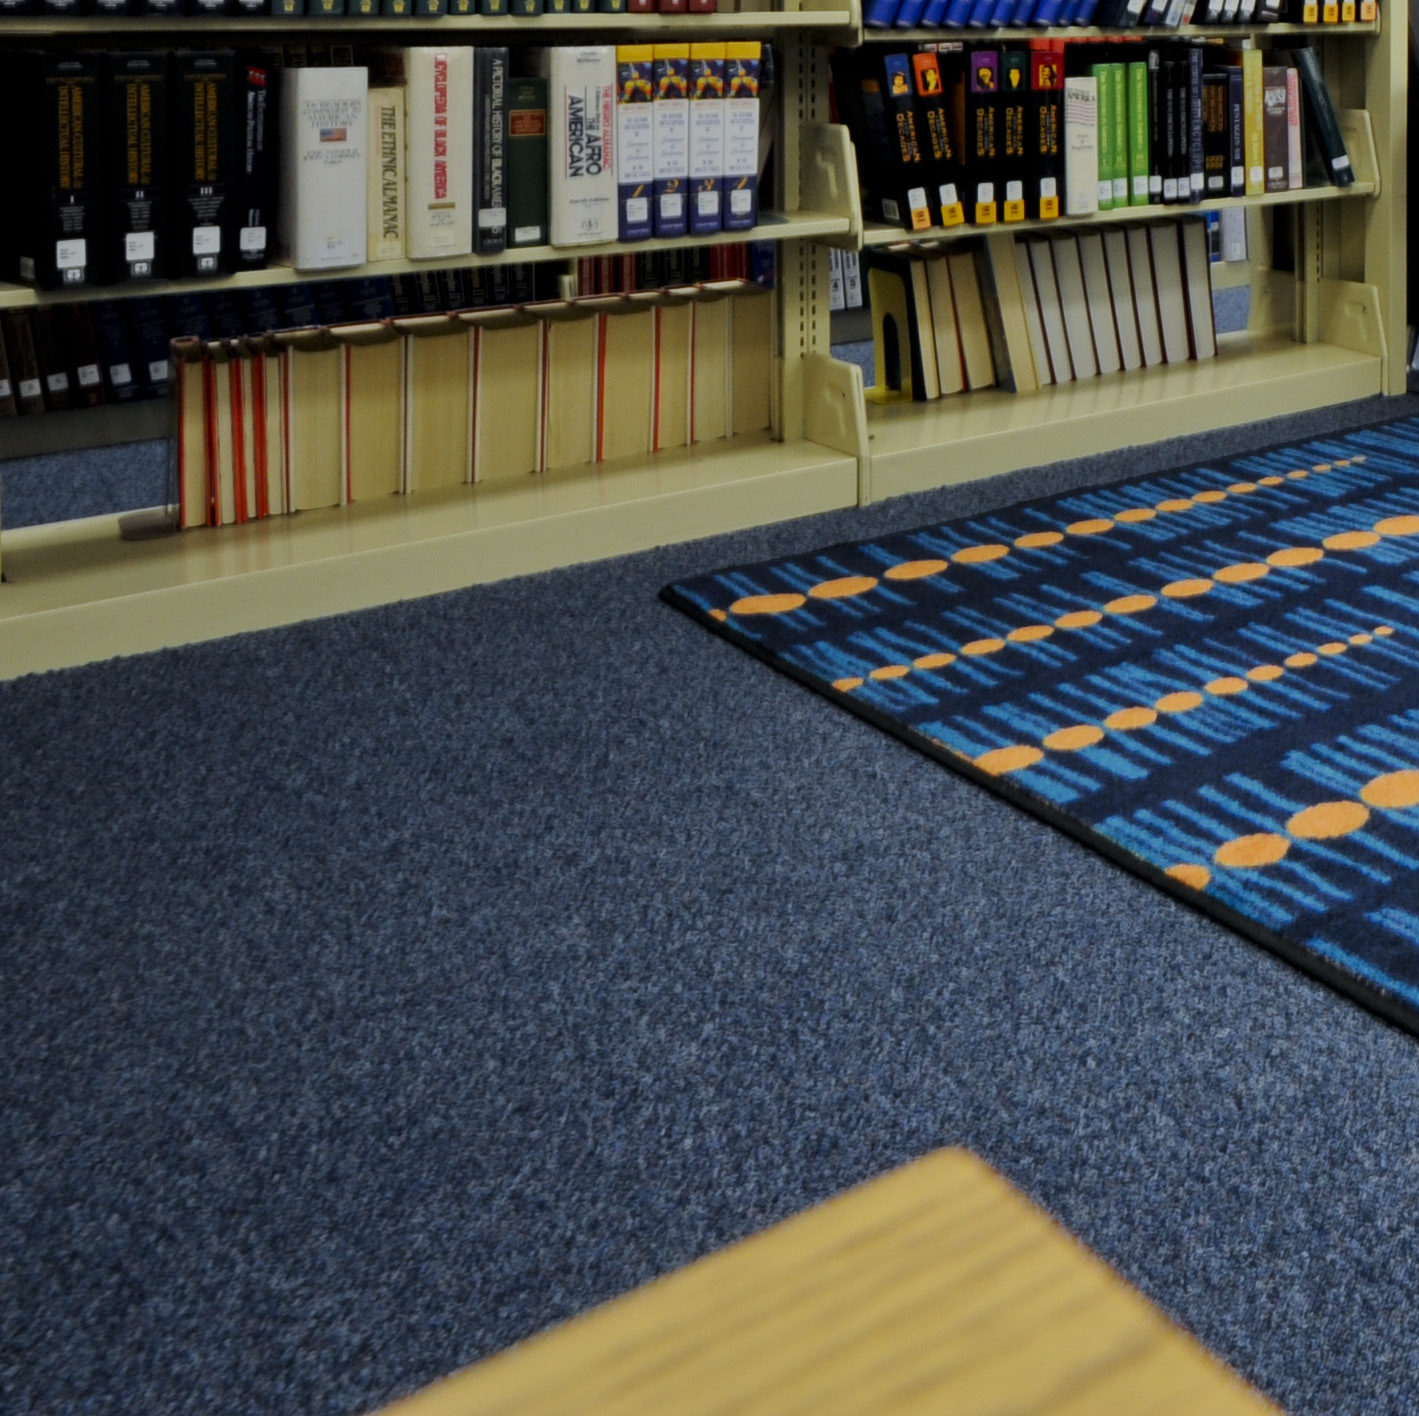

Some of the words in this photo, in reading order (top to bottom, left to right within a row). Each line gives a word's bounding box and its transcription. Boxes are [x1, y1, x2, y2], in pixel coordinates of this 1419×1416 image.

[492, 66, 503, 109] PICTORIAL
[381, 106, 396, 130] THE
[434, 116, 447, 126] OF
[492, 110, 503, 143] HISTORY
[568, 95, 584, 178] AMERICAN
[896, 113, 910, 162] DECADES
[907, 110, 921, 162] AMERICAN
[927, 110, 942, 160] DECADES
[938, 107, 952, 160] AMERICAN
[976, 108, 985, 157] DECADES
[988, 106, 996, 157] AMERICAN
[1005, 107, 1014, 155] DECADES
[1016, 105, 1024, 155] AMERICAN
[1039, 106, 1048, 153] DECADES
[1233, 103, 1241, 145] PENTAGON
[381, 131, 397, 177] ETHNIC
[434, 129, 447, 157] BLACK
[585, 133, 602, 175] AFRO
[434, 159, 447, 198] AMERICA
[492, 158, 503, 185] BLACK
[382, 177, 399, 239] ALMANAC
